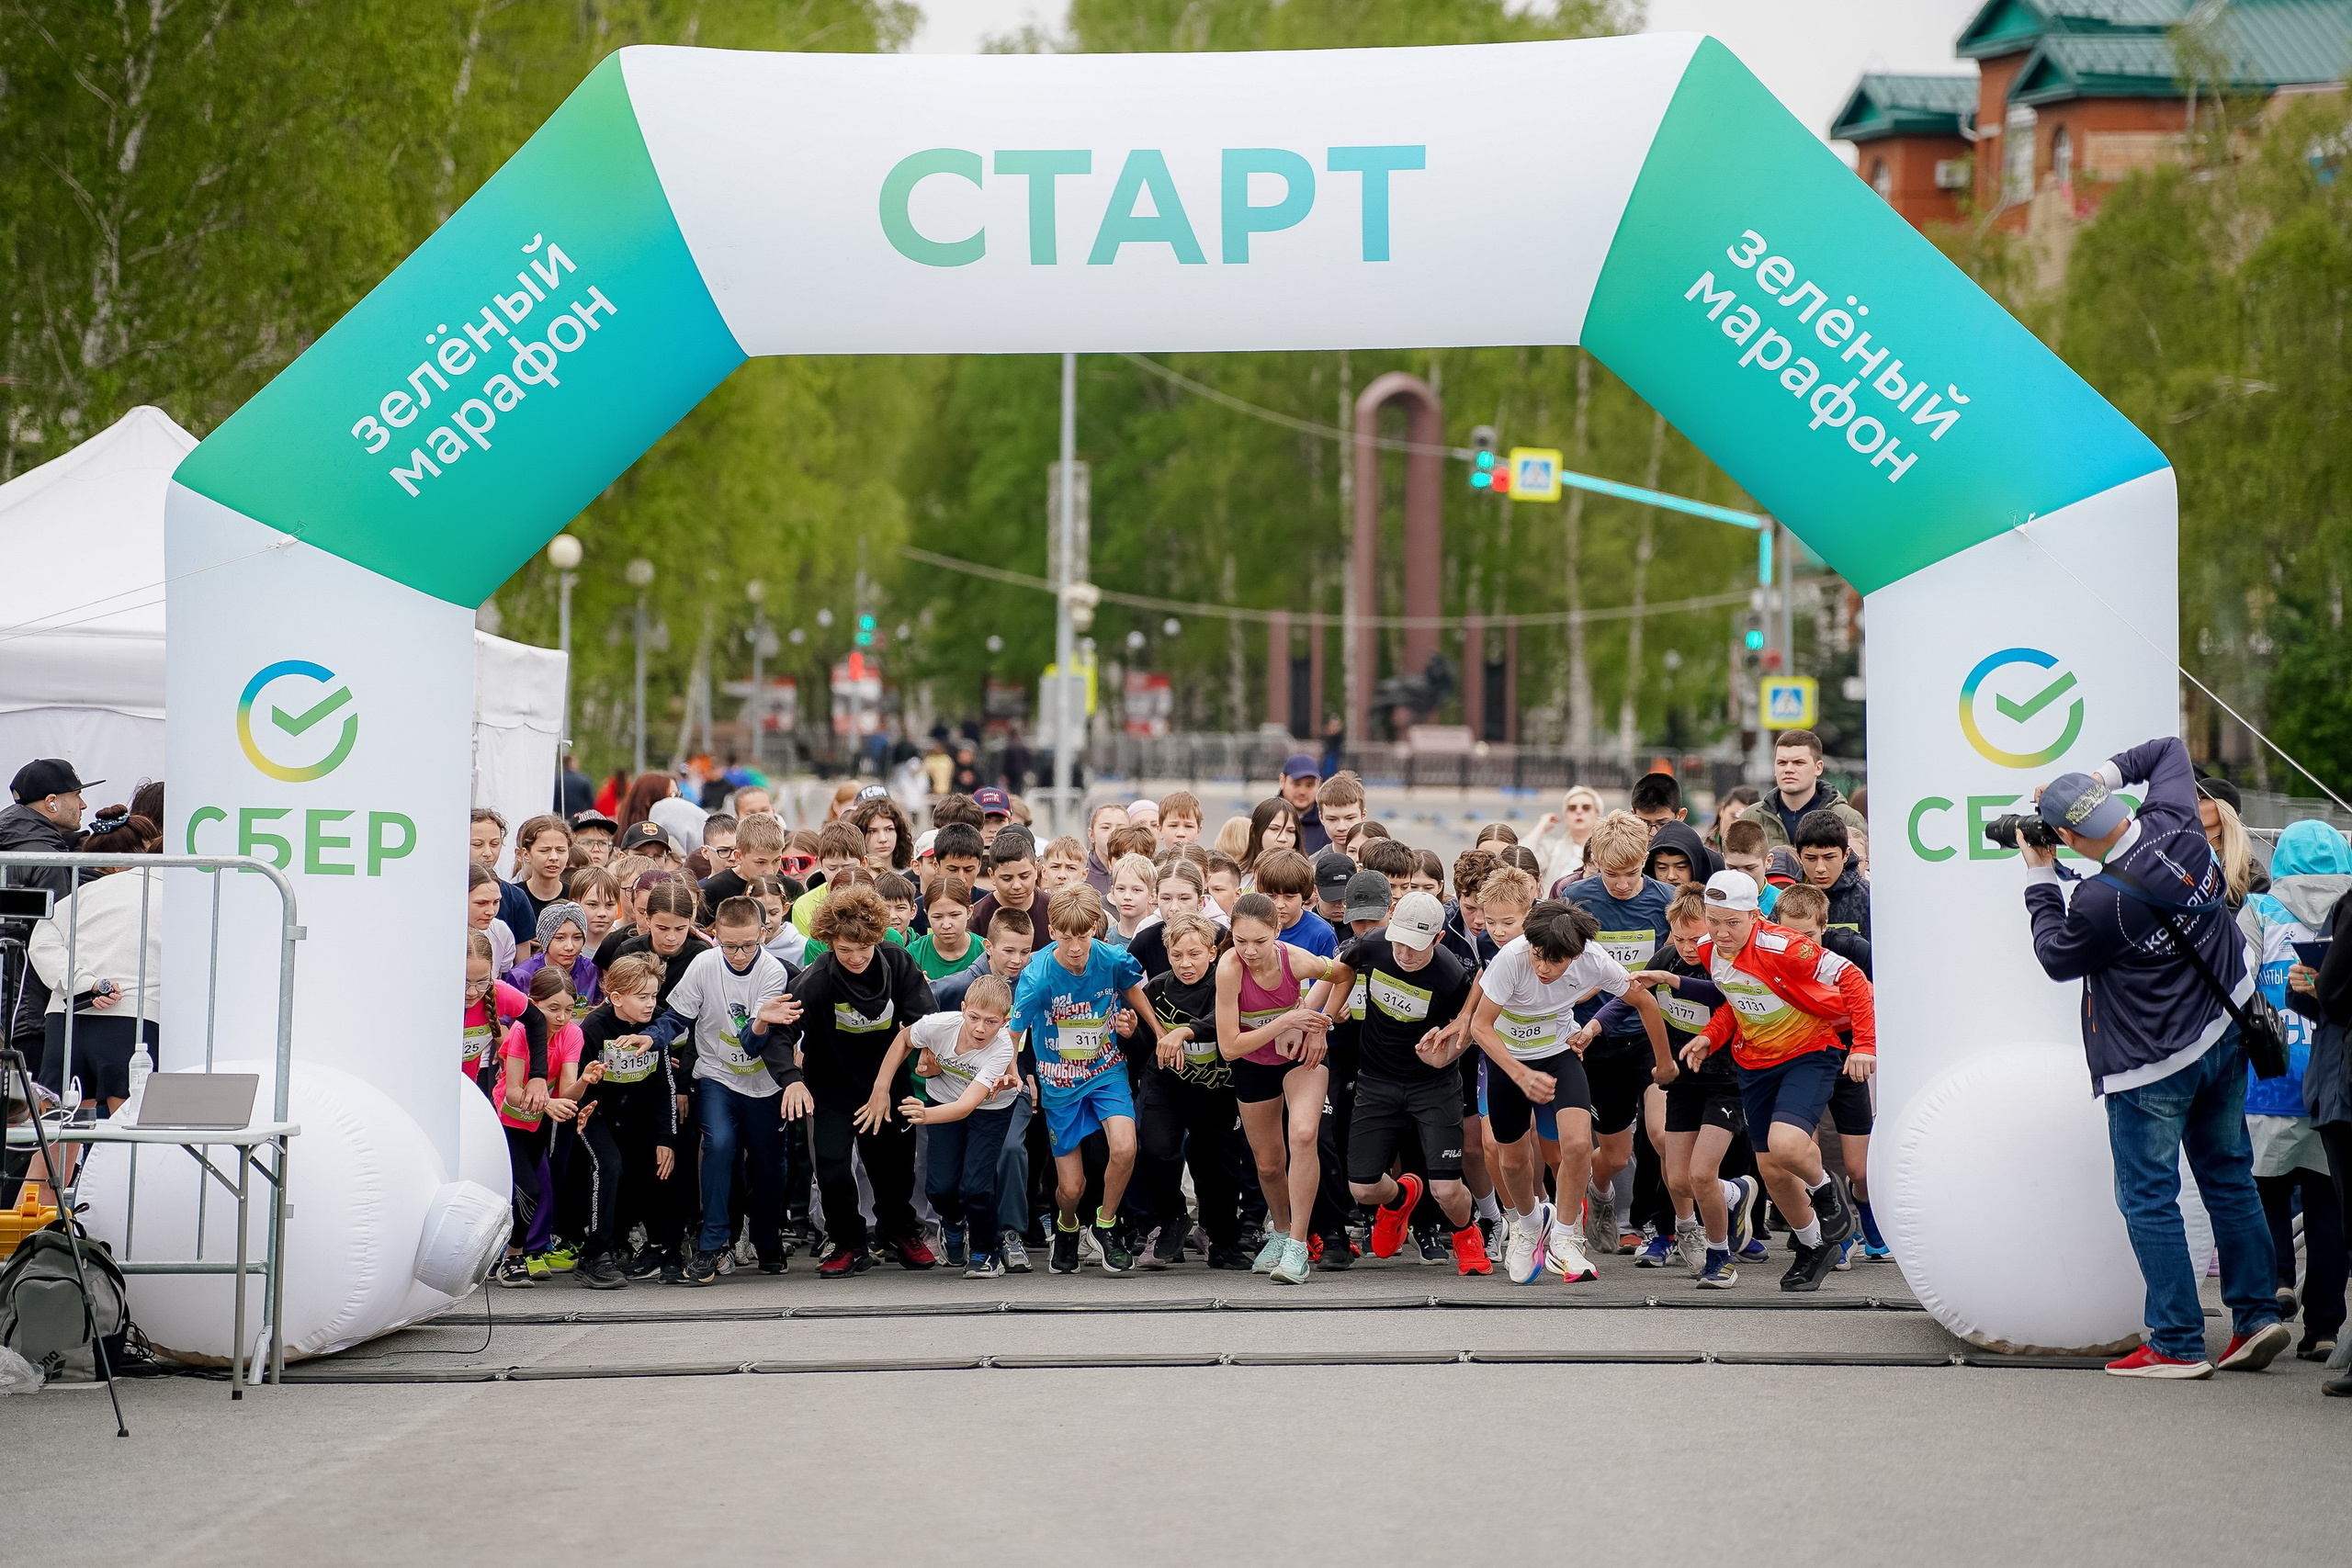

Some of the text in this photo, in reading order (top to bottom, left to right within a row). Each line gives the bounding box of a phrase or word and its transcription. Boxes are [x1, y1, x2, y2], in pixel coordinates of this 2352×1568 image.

[879, 144, 1426, 267] СТАРТ
[350, 231, 578, 455] зелёный
[1726, 229, 1972, 442] зелёный
[389, 285, 618, 498] марафон
[1683, 270, 1919, 484] марафон
[187, 806, 417, 876] СБЕР
[1608, 950, 1640, 962] 3167
[1383, 992, 1411, 1012] 3146
[1668, 1003, 1695, 1021] 3177
[1737, 999, 1766, 1011] 3131
[1510, 1026, 1542, 1039] 3208
[620, 1055, 650, 1069] 3150
